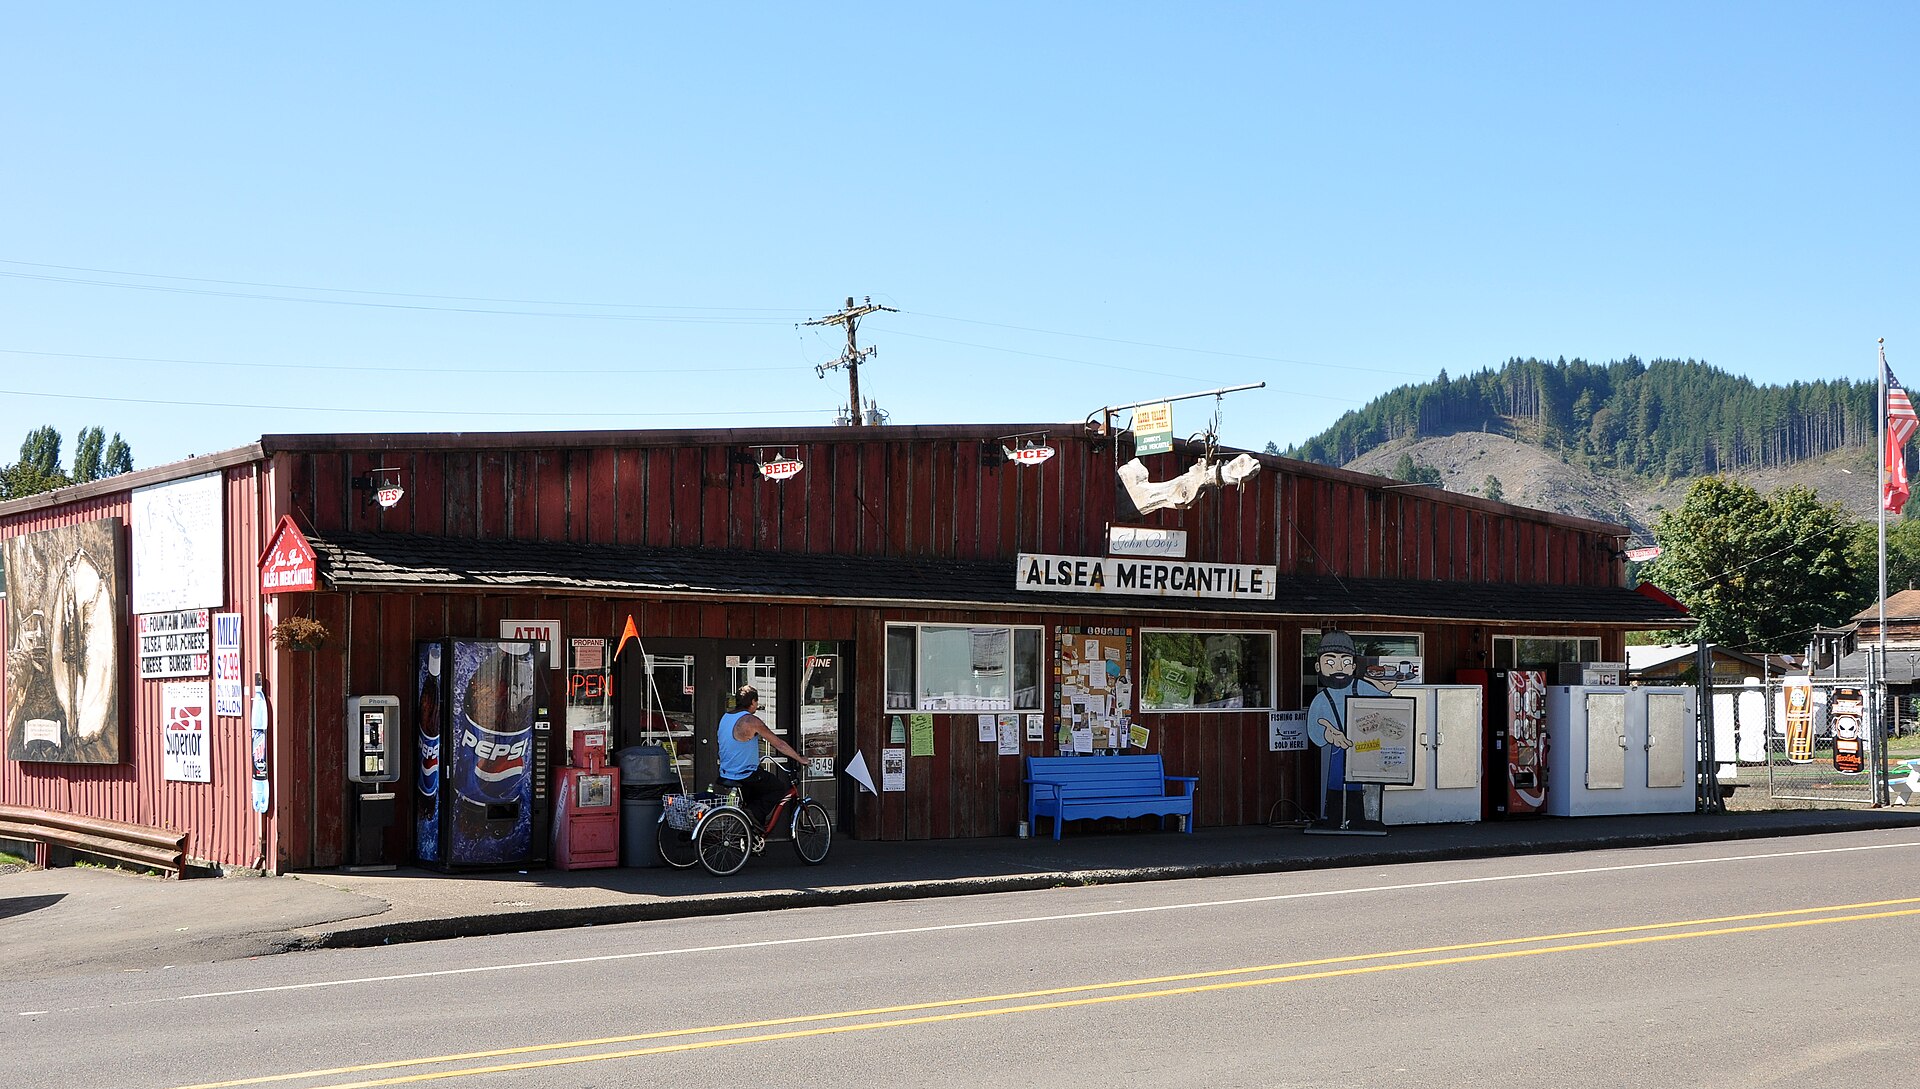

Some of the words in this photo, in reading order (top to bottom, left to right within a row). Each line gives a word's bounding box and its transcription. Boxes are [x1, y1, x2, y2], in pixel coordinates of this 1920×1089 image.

[1016, 449, 1048, 460] ICE
[765, 462, 797, 475] BEER
[379, 489, 397, 502] YES
[1112, 533, 1142, 551] John
[1145, 531, 1179, 553] Boy's
[279, 567, 313, 587] MERCANTILE
[1026, 559, 1105, 587] ALSEA
[1116, 563, 1263, 594] MERCANTILE
[180, 612, 198, 629] DRINK
[217, 616, 239, 646] MILK
[513, 627, 550, 641] ATM
[143, 636, 161, 653] ALSEA
[184, 632, 205, 650] CHEESE
[142, 656, 162, 673] CHEESE
[169, 654, 192, 672] BURGER
[566, 674, 613, 698] PEN
[1599, 674, 1617, 686] ICE
[216, 699, 241, 713] GALLON
[1270, 712, 1293, 722] FISHING
[1294, 712, 1307, 721] BAIT
[166, 723, 202, 764] Superior
[461, 728, 530, 762] PEPSI
[1274, 741, 1289, 750] SOLD
[1289, 740, 1304, 749] HERE
